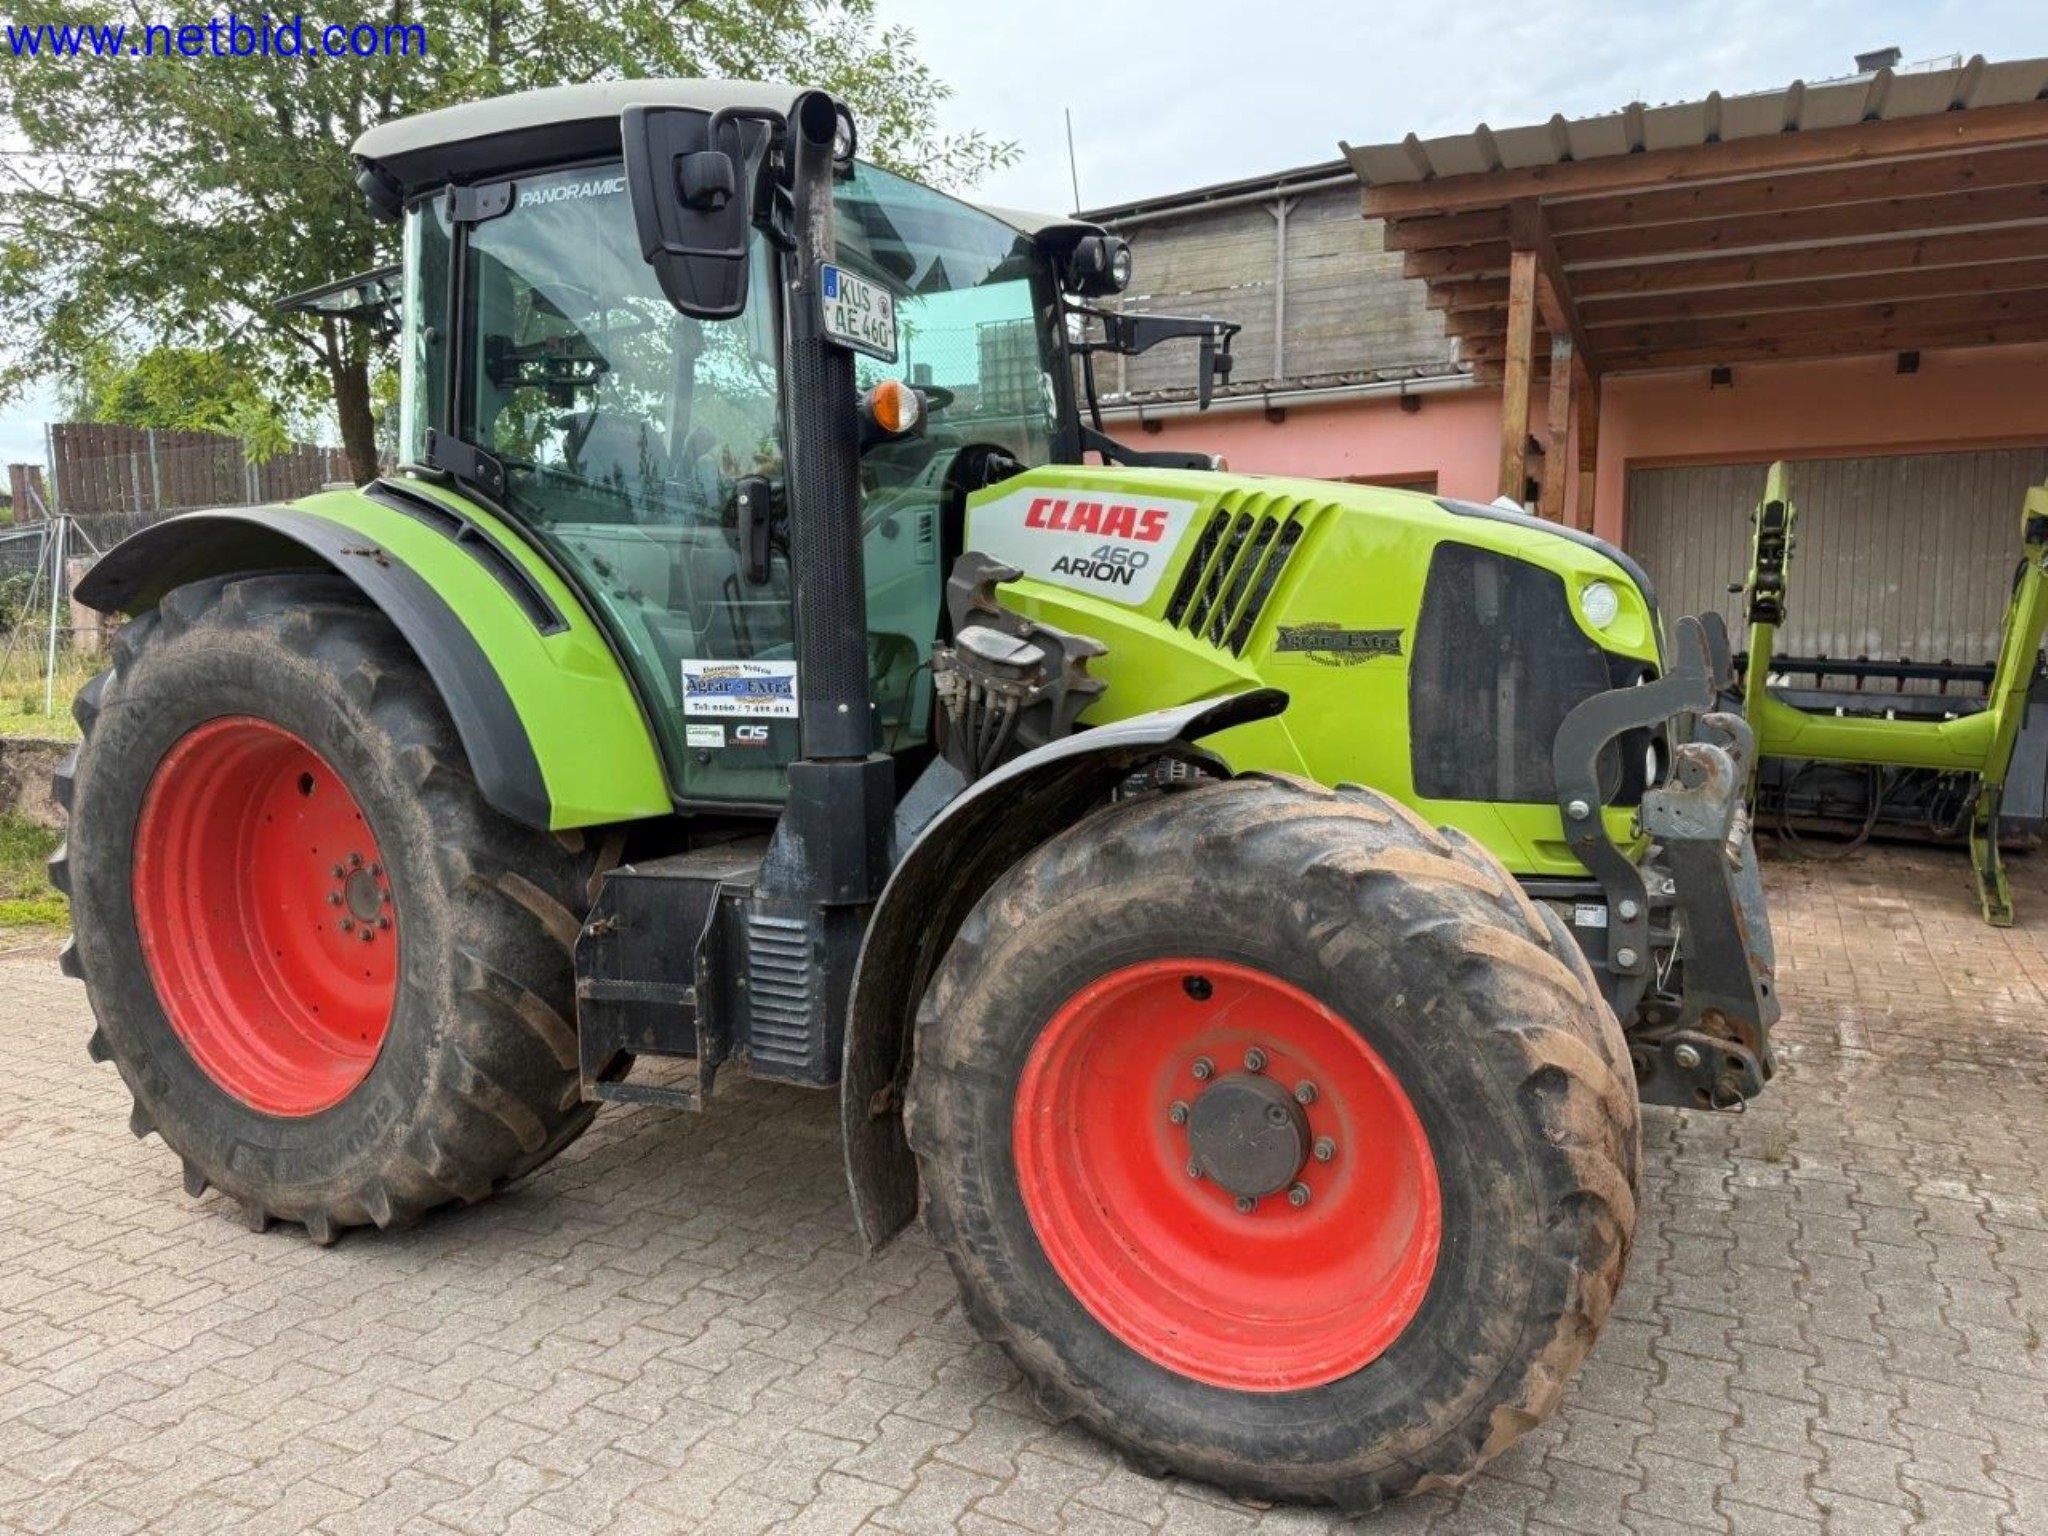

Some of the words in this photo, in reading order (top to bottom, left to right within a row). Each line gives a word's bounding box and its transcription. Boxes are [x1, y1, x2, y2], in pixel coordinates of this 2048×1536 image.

[520, 177, 626, 207] PANORAMIC
[839, 275, 871, 313] KUS
[836, 305, 860, 336] AE
[862, 315, 889, 348] 460
[1025, 498, 1169, 542] CLAAS
[1051, 555, 1136, 586] ARION
[1091, 544, 1150, 570] 460
[685, 679, 732, 694] Agrar
[747, 680, 793, 694] Extra
[735, 725, 769, 740] CIS
